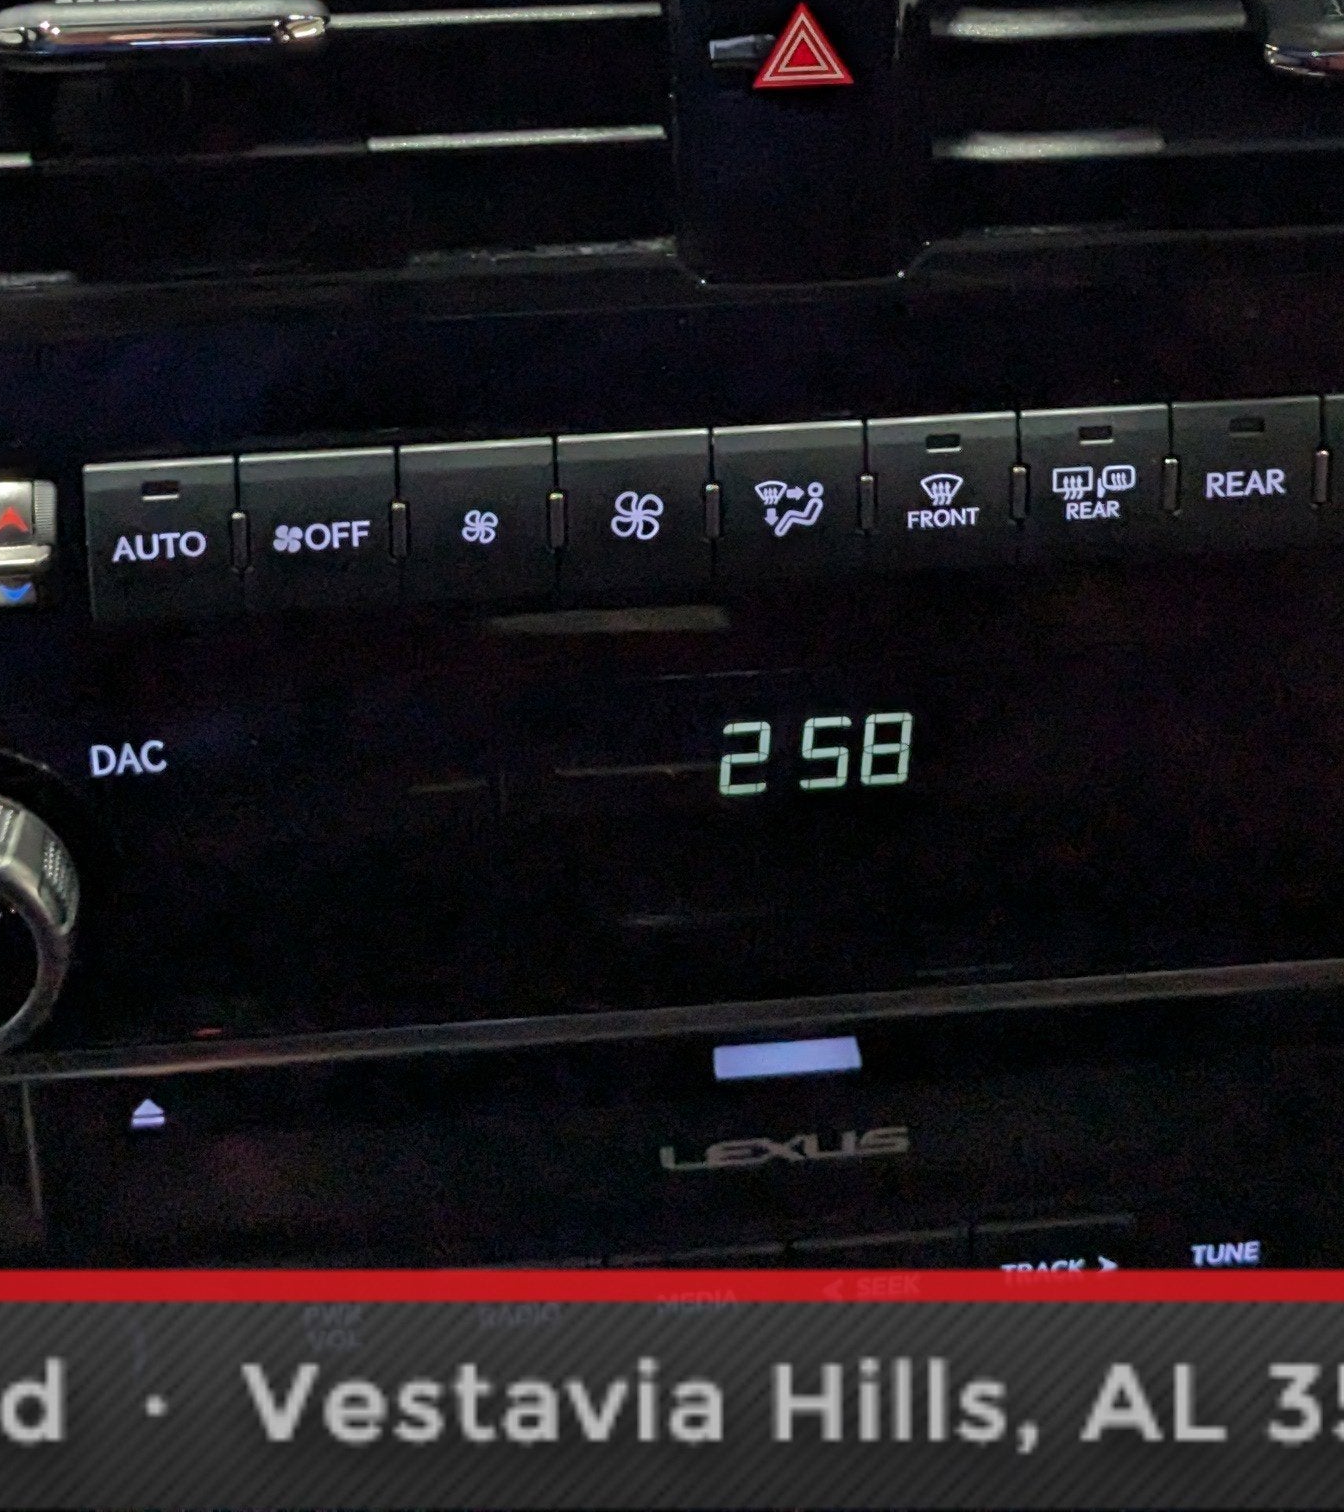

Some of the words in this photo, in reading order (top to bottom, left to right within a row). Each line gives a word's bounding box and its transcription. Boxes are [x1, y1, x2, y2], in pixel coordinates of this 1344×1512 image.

[1205, 467, 1286, 500] REAR
[907, 505, 980, 530] FRONT
[1065, 500, 1120, 522] REAR
[112, 531, 207, 564] AUTO
[304, 519, 370, 552] OFF
[89, 739, 168, 777] DAC
[659, 1126, 910, 1172] LEXUS
[1190, 1240, 1261, 1267] TUNE
